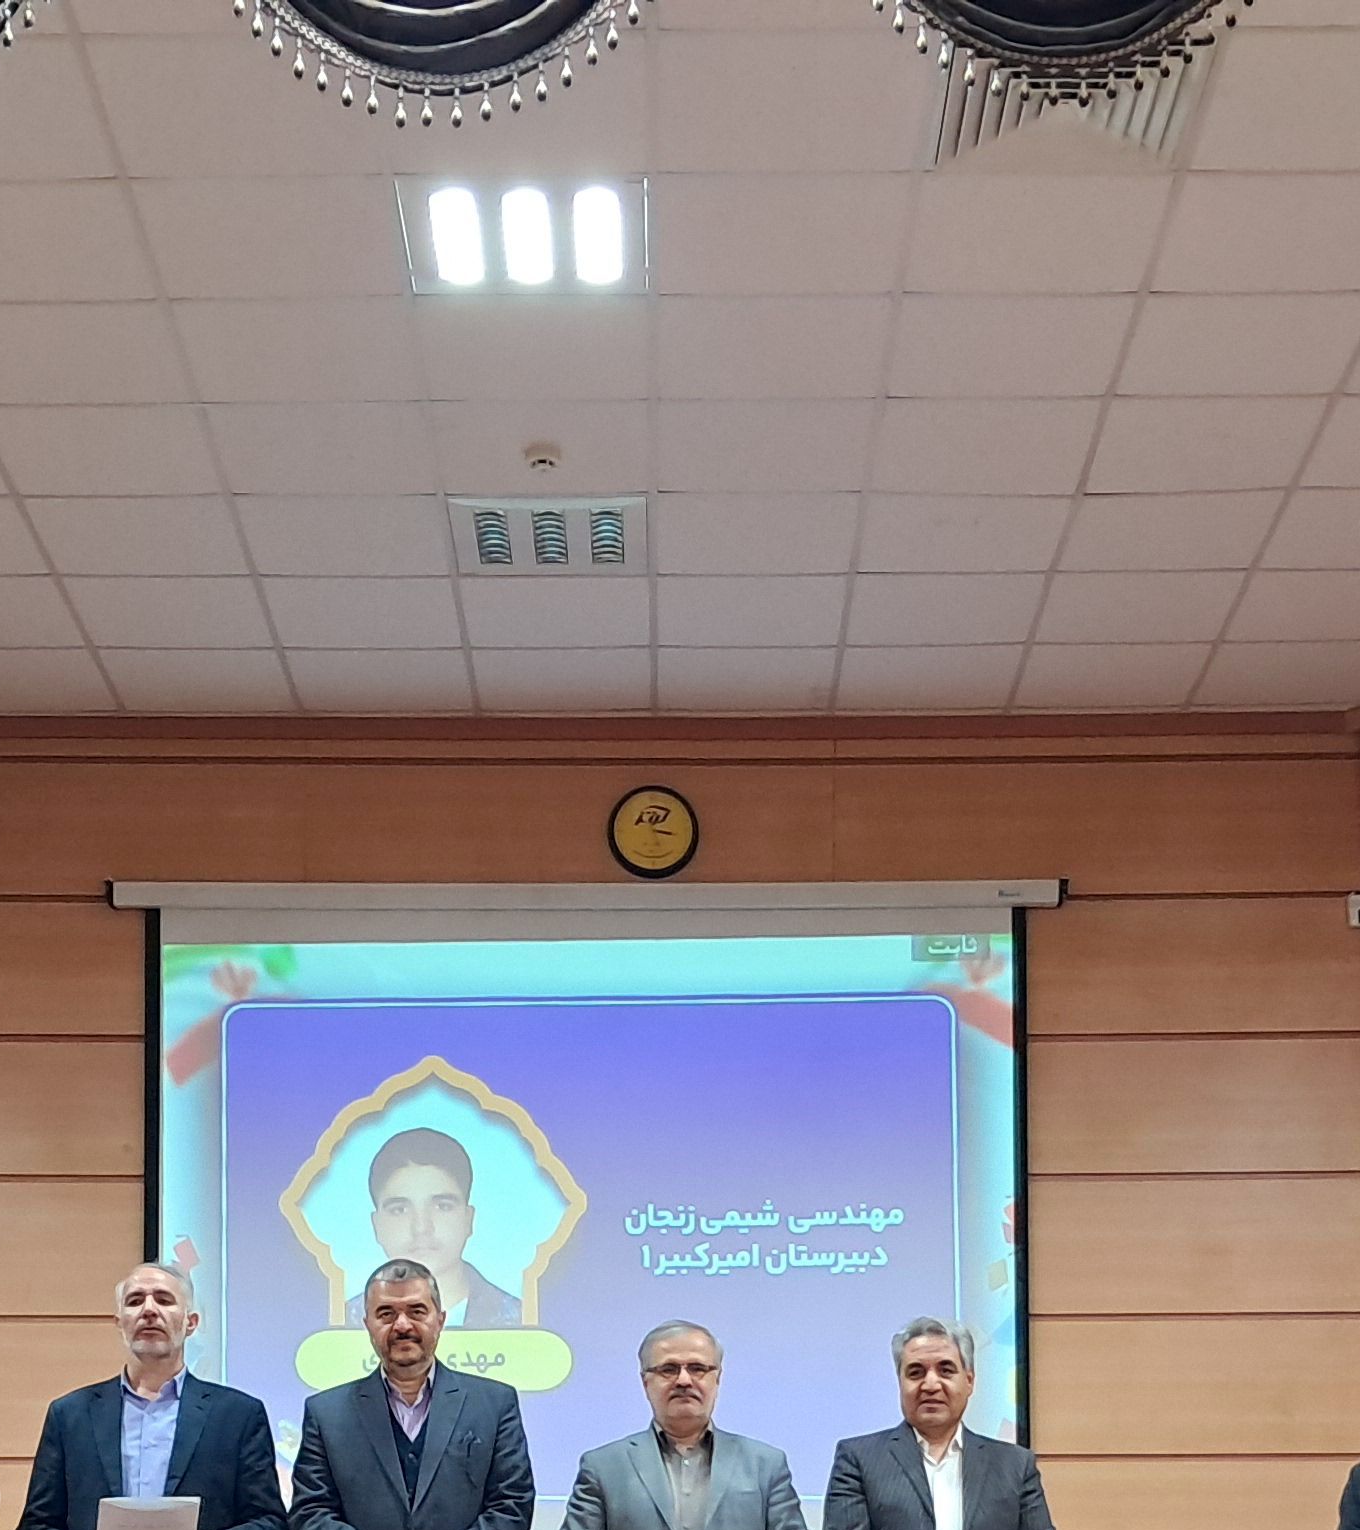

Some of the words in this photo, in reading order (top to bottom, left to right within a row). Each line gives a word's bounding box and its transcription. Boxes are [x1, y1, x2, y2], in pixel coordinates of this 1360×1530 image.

[928, 934, 978, 957] ثابت
[624, 1203, 696, 1235] زنجان
[700, 1199, 780, 1234] شیمی
[787, 1203, 905, 1233] مهندسی
[764, 1243, 888, 1275] دبیرستان
